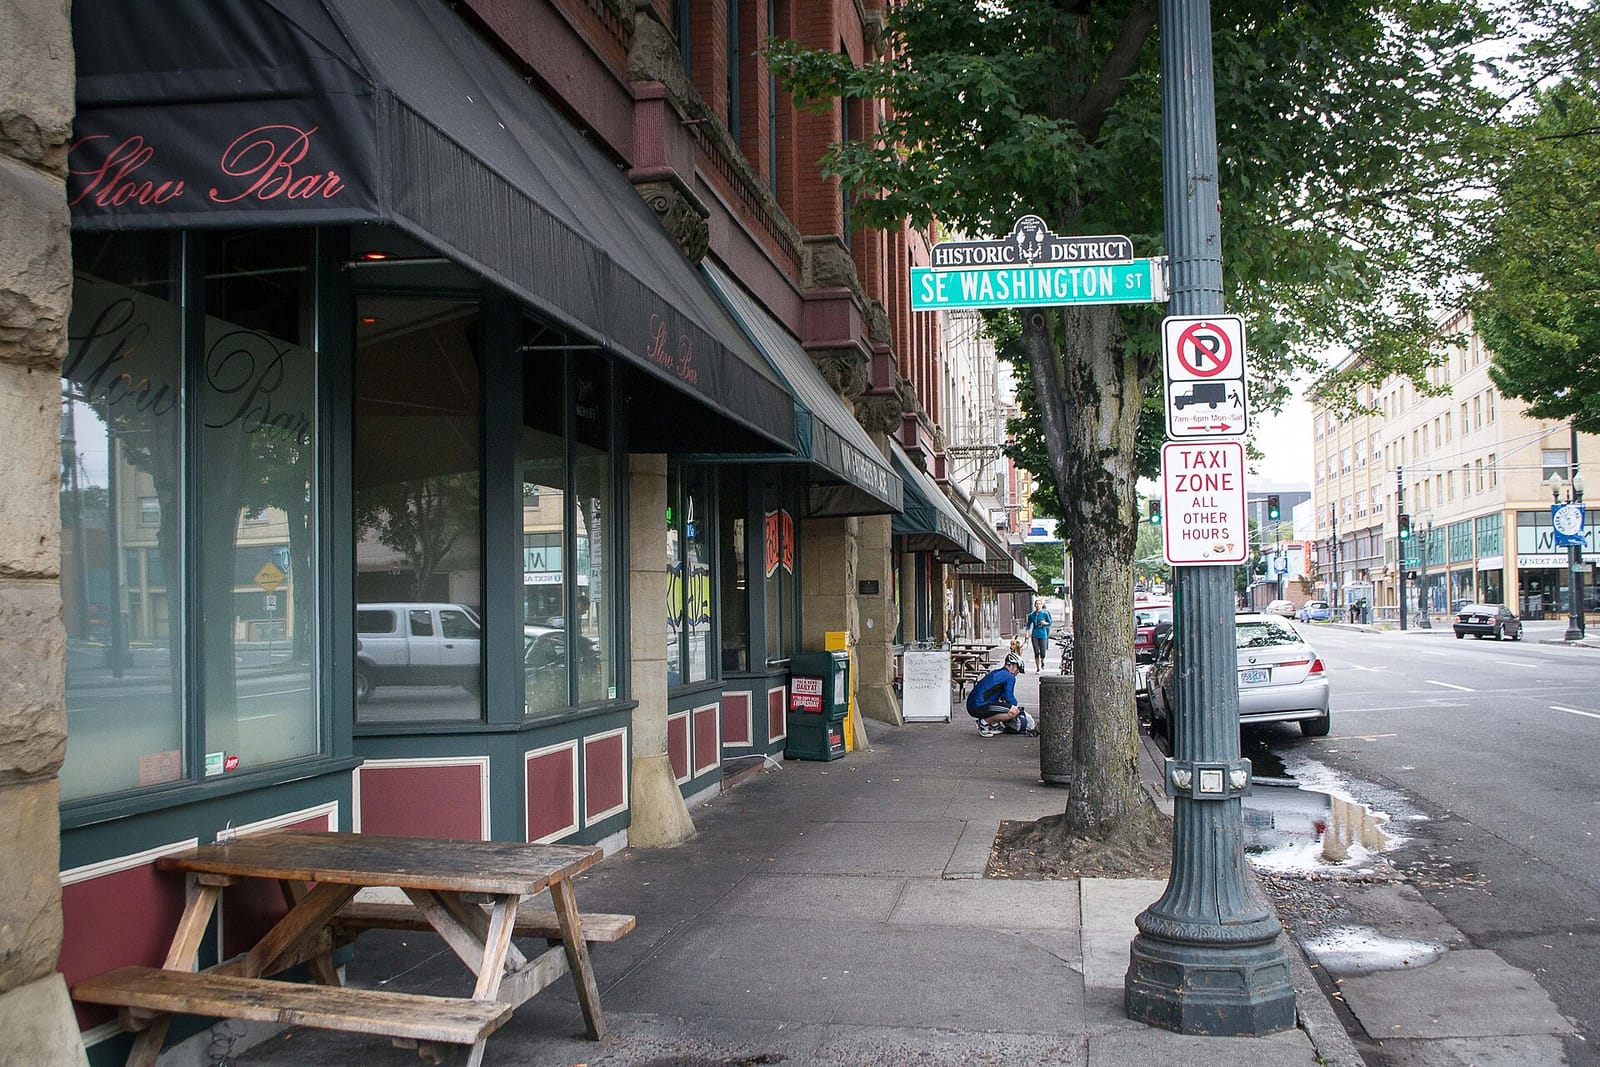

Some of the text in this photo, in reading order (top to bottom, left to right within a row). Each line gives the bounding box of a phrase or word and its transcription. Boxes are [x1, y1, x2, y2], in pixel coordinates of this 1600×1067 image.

[69, 124, 345, 207] Slow Bar
[935, 241, 1127, 265] HISTORIC DISTRICT
[921, 267, 1143, 303] SE WASHINGTON ST
[647, 312, 698, 385] Slow Bar
[1180, 450, 1227, 469] TAXI
[1175, 473, 1233, 492] ZONE
[1192, 496, 1218, 508] ALL
[1183, 512, 1227, 524] OTHER
[1182, 528, 1230, 540] HOURS
